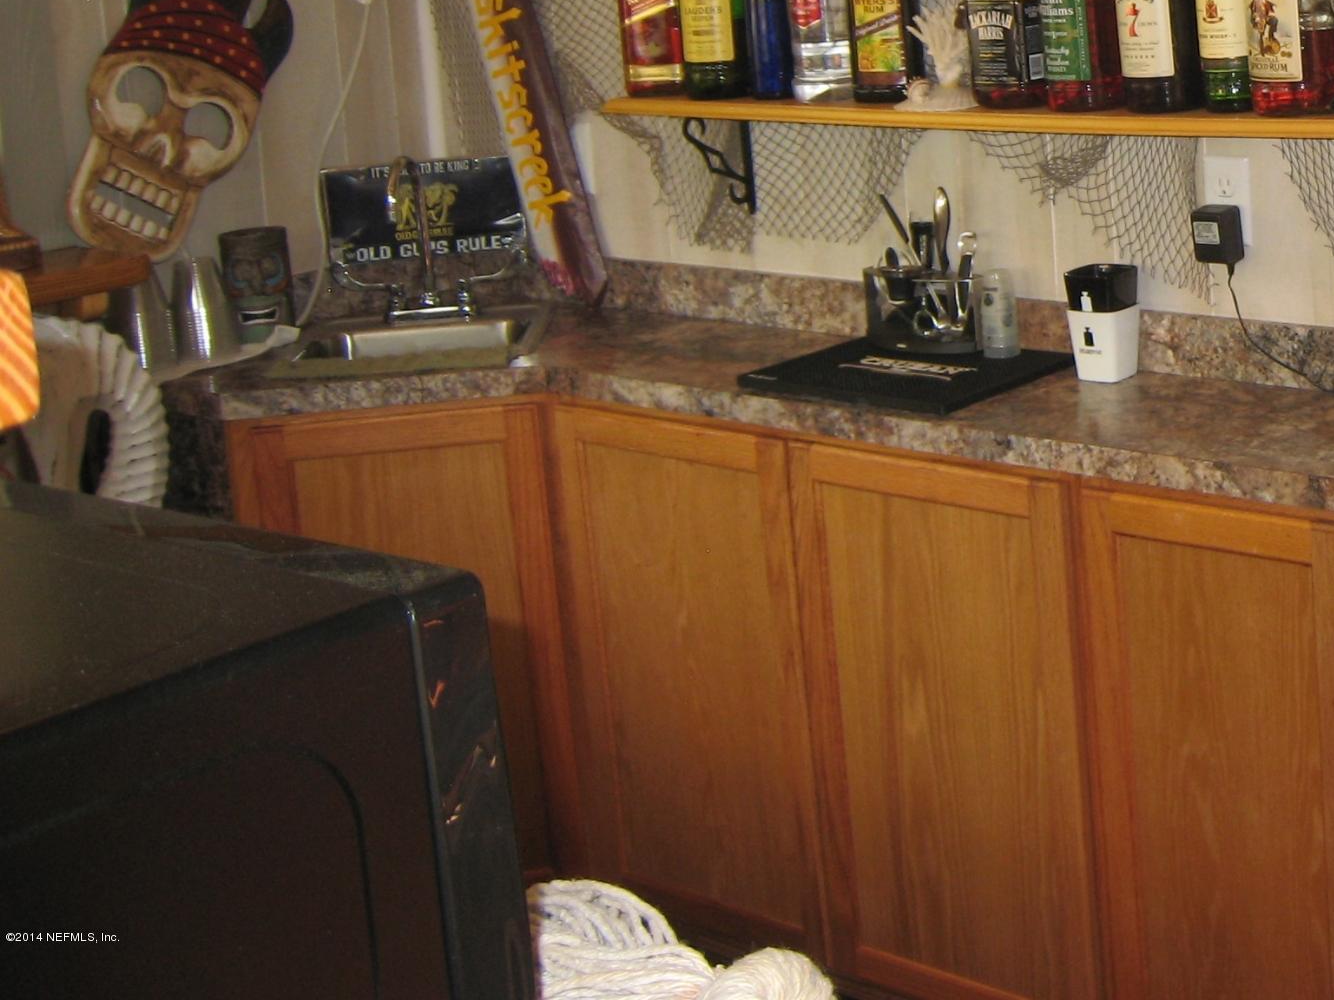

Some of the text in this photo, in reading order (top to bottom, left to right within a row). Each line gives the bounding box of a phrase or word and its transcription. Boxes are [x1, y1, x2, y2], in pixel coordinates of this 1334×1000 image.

[863, 5, 884, 14] RUM
[420, 162, 432, 175] TO
[355, 245, 392, 262] OLD
